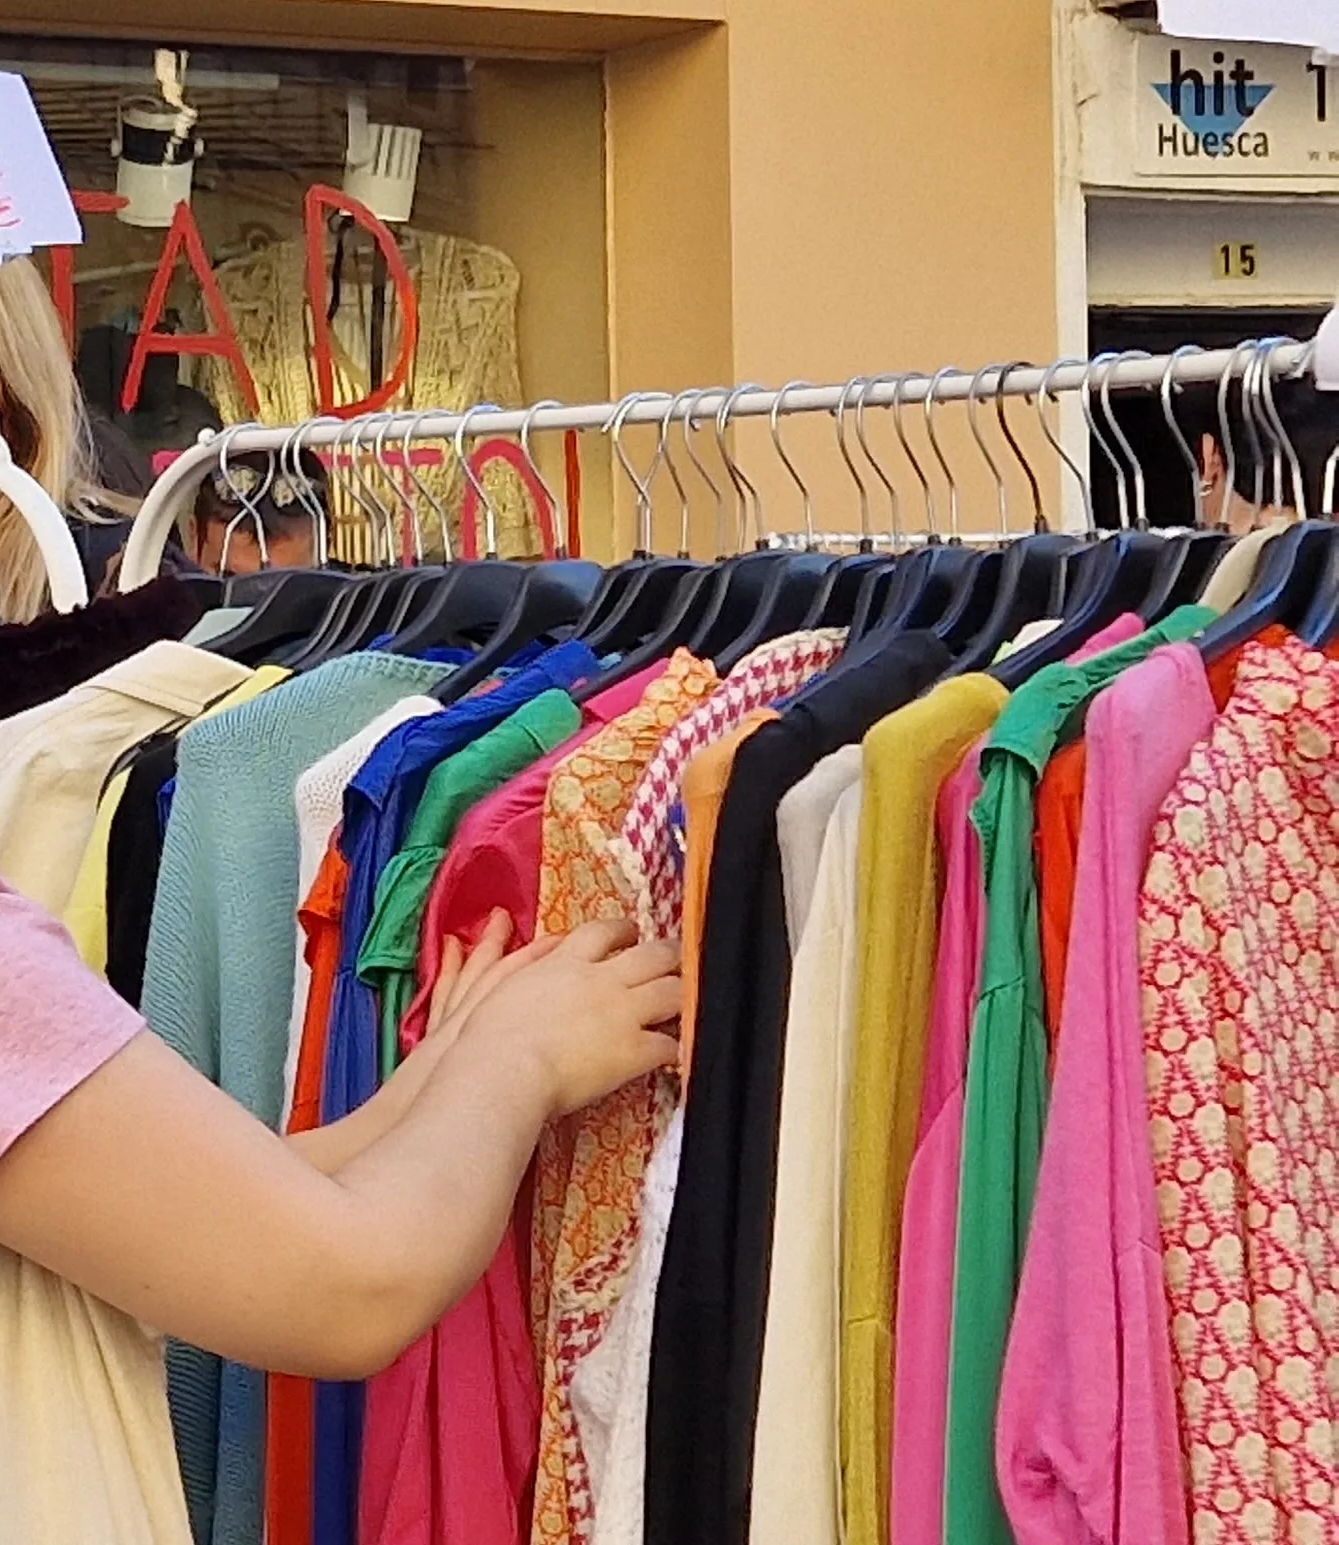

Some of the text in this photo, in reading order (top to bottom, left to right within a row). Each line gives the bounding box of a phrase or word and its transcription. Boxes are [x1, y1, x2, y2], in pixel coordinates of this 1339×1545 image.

[1170, 49, 1254, 117] hit
[1158, 123, 1269, 157] Huesca
[1221, 244, 1255, 276] 15
